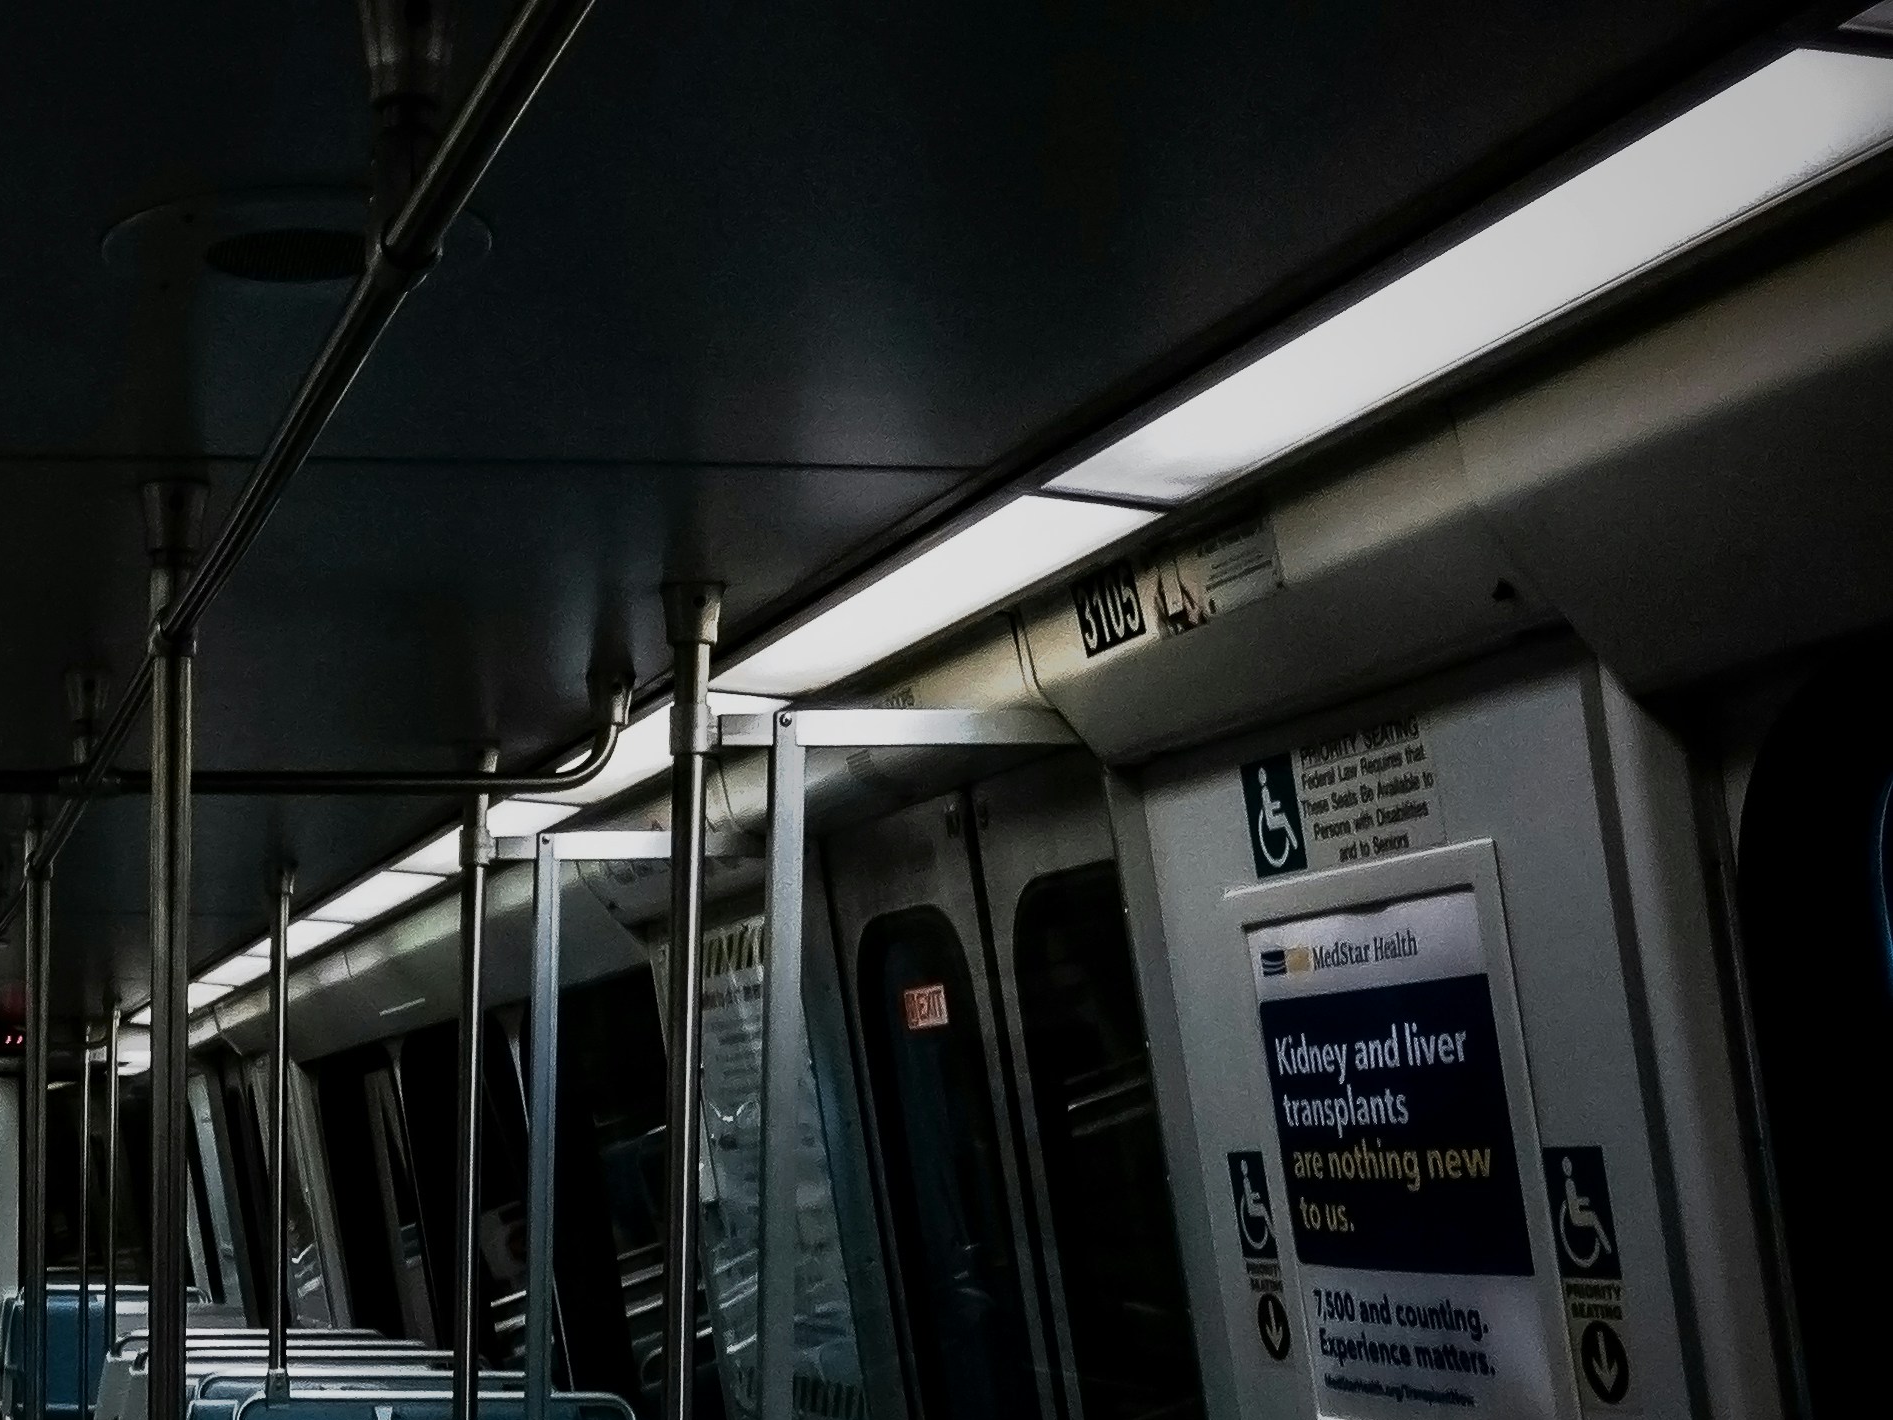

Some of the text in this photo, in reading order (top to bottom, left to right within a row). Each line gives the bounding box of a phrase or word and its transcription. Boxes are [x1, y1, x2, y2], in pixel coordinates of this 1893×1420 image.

[1074, 566, 1141, 650] 3105
[1300, 712, 1419, 766] PRIORITY SEATING
[1312, 930, 1418, 970] MedStar Health
[917, 990, 942, 1020] EXIT
[1275, 1021, 1467, 1085] Kidney and liver
[1282, 1083, 1409, 1139] transplants
[1293, 1138, 1491, 1192] are nothing new
[1300, 1197, 1355, 1233] to us.
[1313, 1289, 1489, 1341] 7,500 and counting.
[1565, 1283, 1621, 1300] PRIORITY
[1319, 1328, 1496, 1376] Experience matters.
